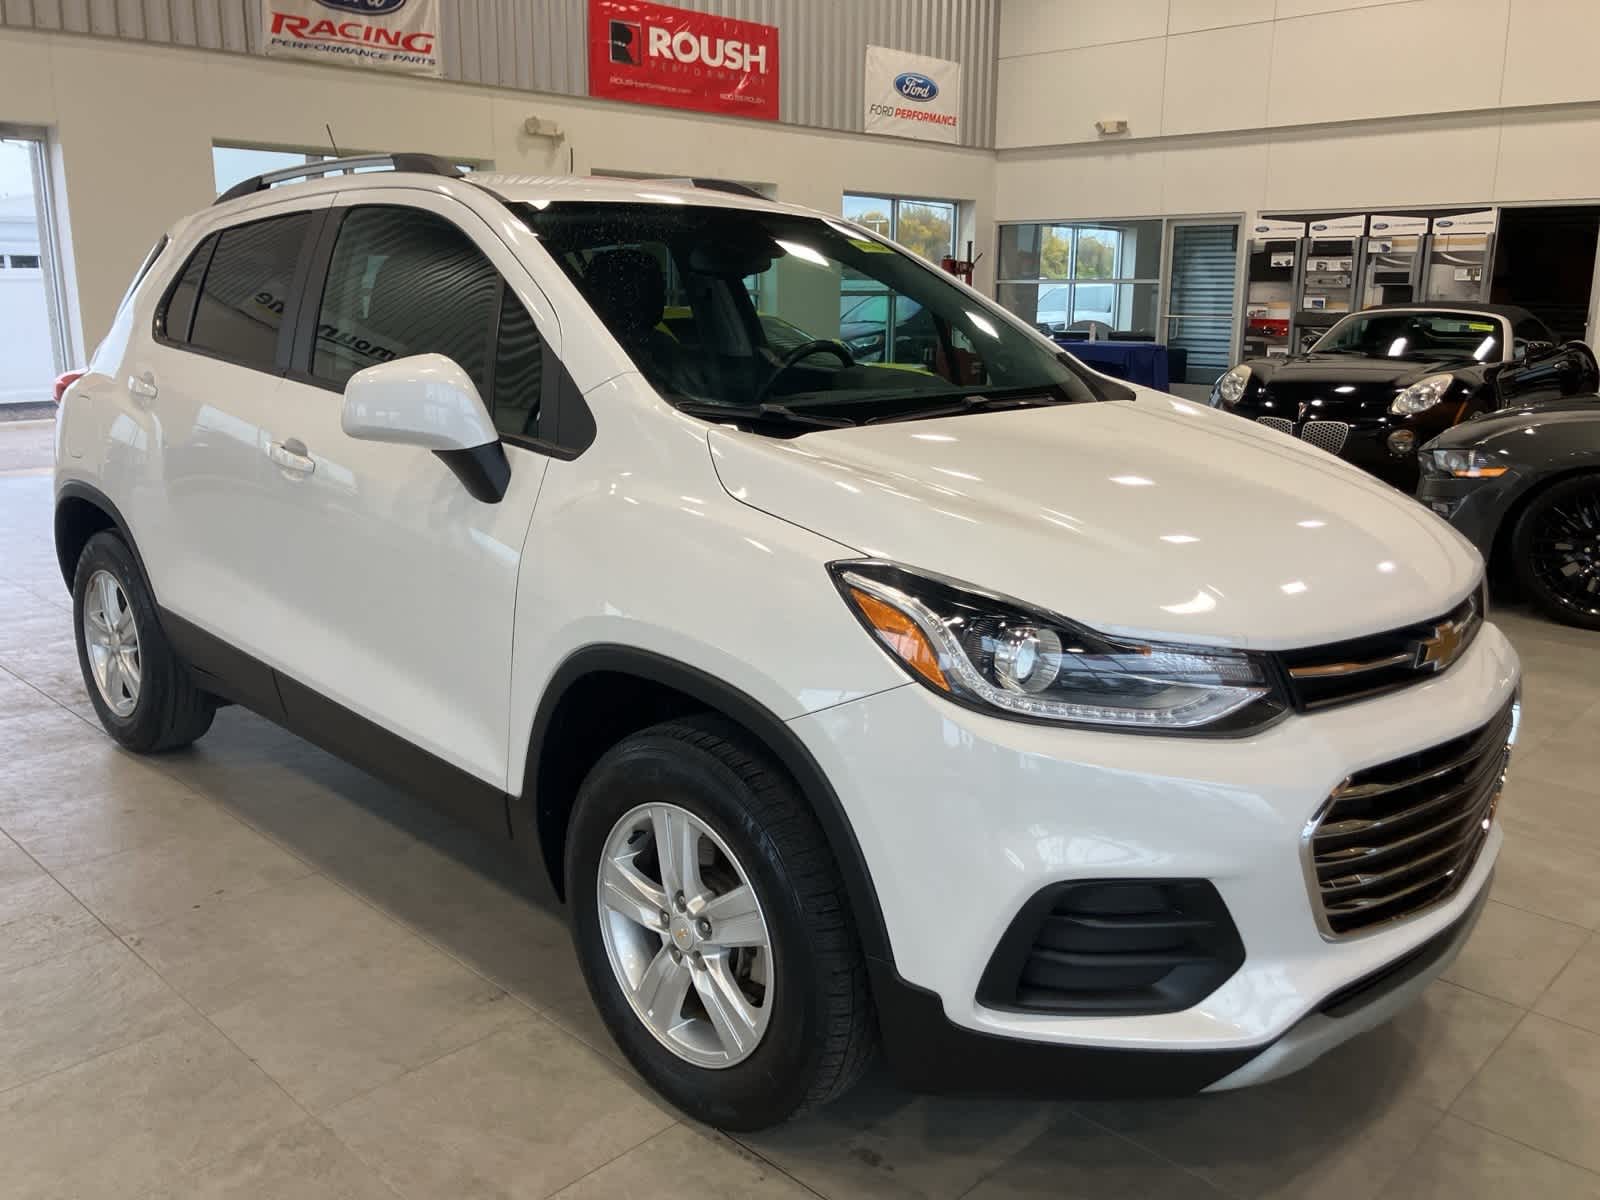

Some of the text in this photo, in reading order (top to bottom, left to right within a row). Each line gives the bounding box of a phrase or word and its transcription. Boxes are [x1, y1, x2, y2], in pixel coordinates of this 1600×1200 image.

[271, 12, 435, 54] RACING
[271, 38, 436, 65] PERFORMANCE PARTS
[649, 26, 766, 74] ROUSH
[902, 76, 930, 98] Ford
[870, 104, 957, 127] FORD PERFORMANCE
